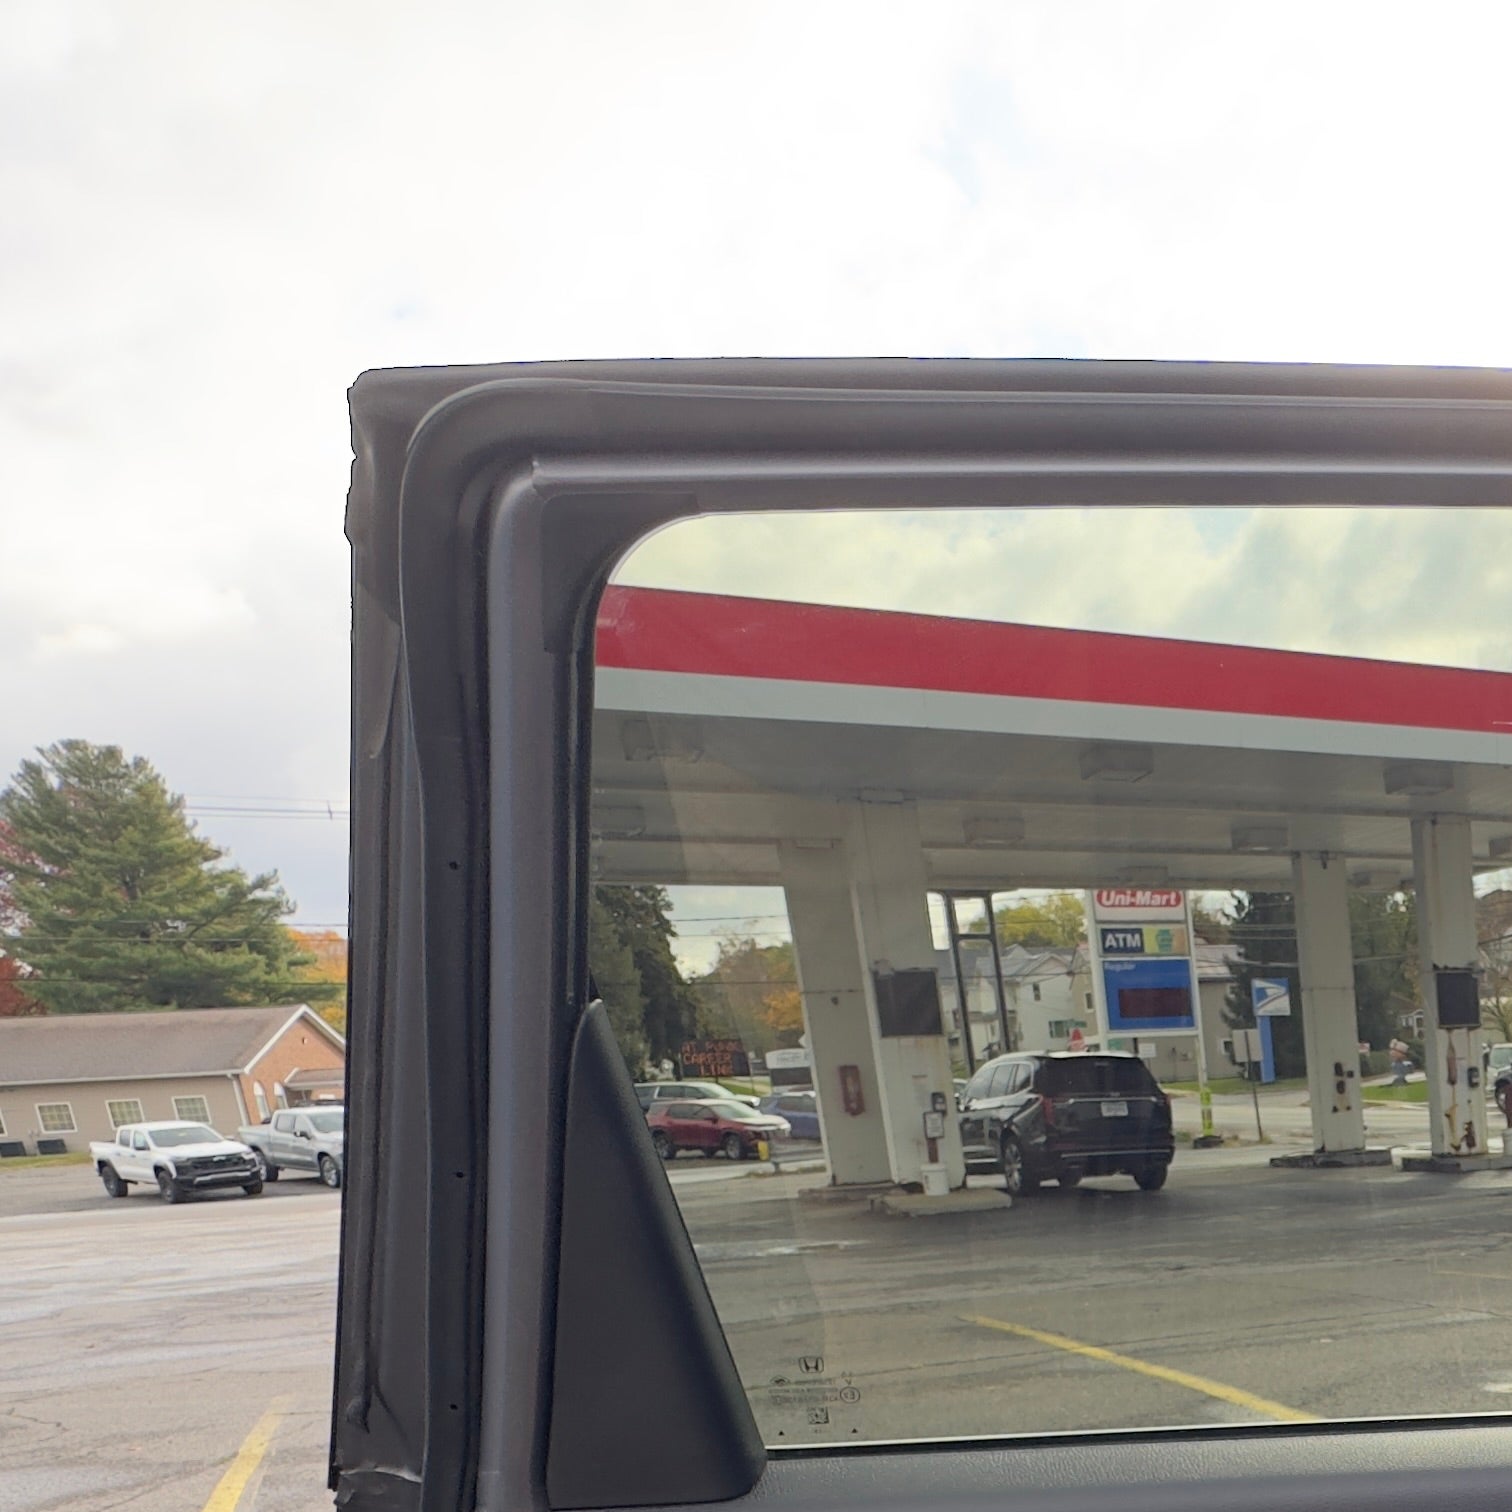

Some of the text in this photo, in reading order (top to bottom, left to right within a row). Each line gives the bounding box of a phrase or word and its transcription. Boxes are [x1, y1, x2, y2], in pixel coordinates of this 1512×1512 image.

[1102, 890, 1177, 905] Uni-Mart
[1104, 933, 1141, 948] ATM
[683, 1053, 731, 1065] CAREER
